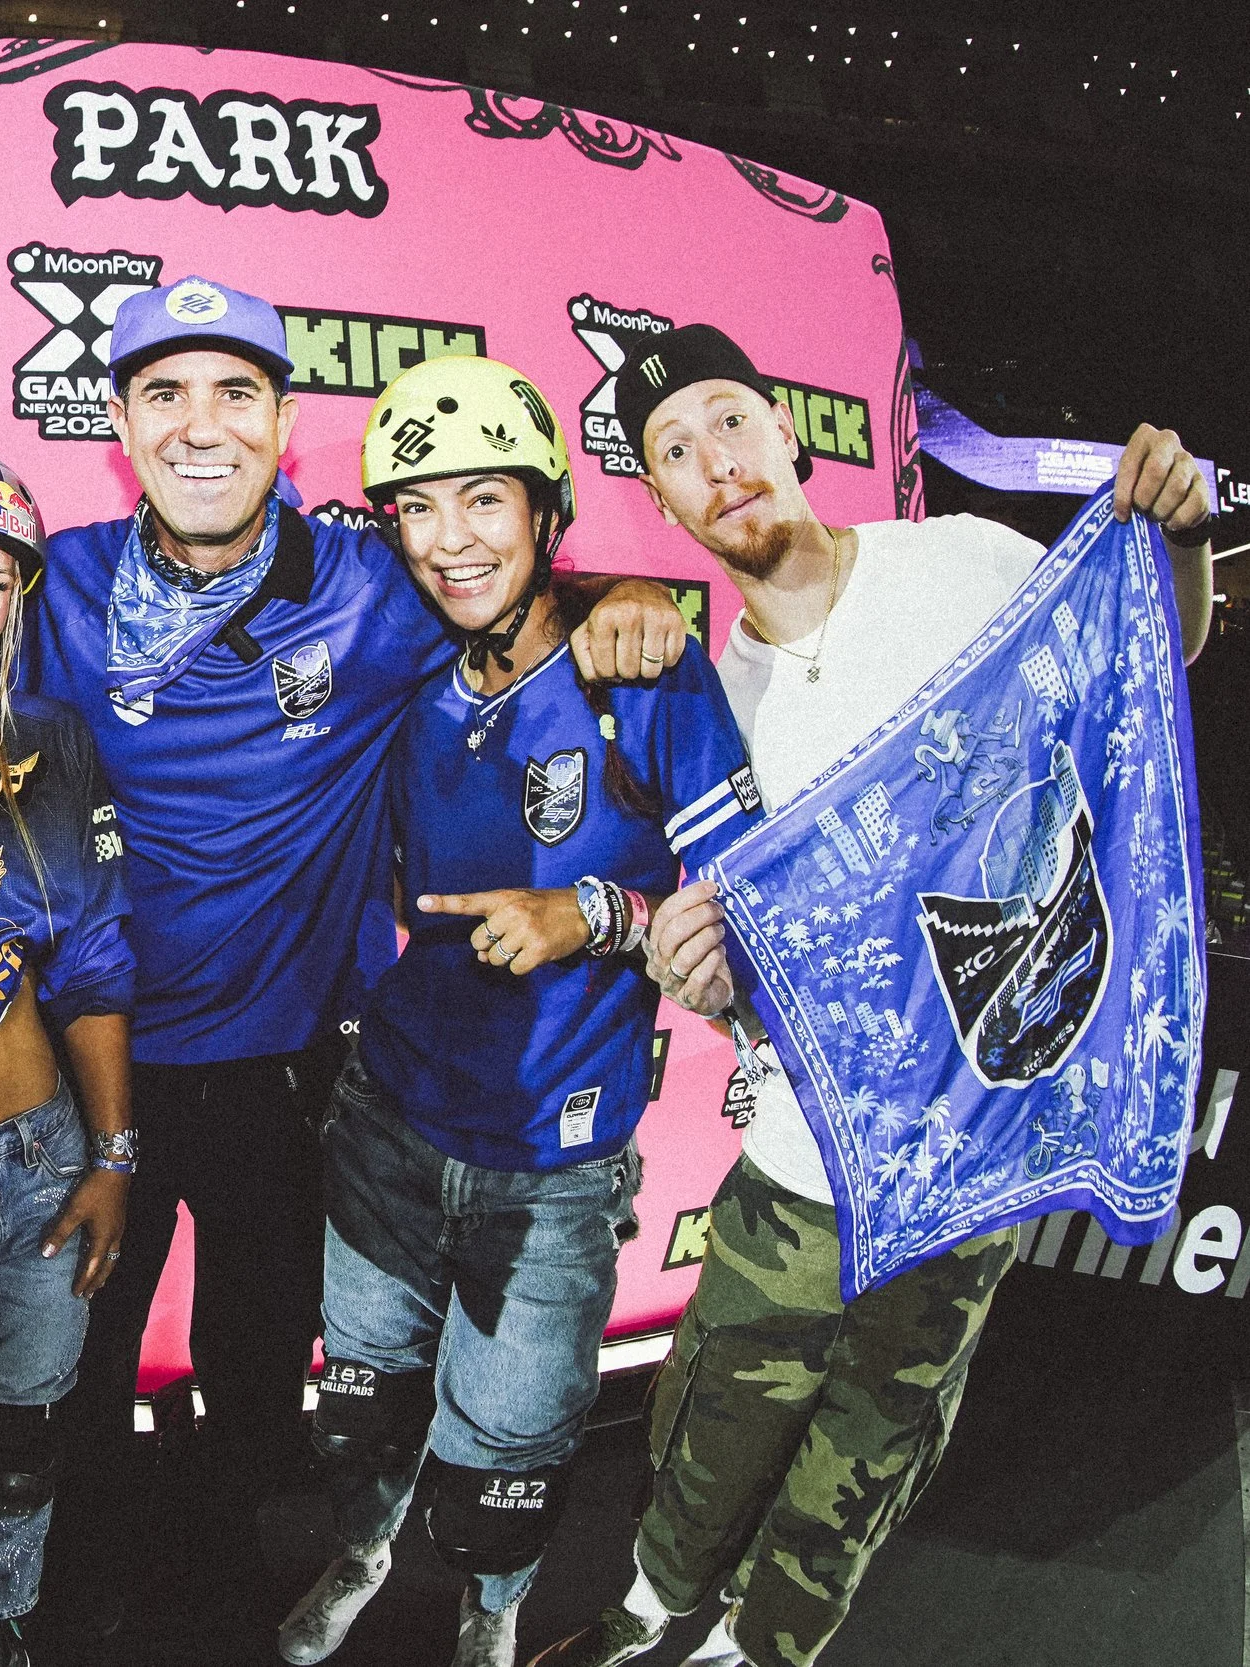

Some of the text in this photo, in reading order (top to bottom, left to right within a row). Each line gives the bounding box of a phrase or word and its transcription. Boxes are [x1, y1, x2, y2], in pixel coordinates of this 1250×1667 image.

[63, 90, 376, 202] PARK
[45, 253, 156, 280] MoonPay
[20, 402, 66, 414] NEW
[46, 416, 113, 435] 202
[770, 385, 869, 460] ICK
[586, 439, 619, 453] NEW
[8, 513, 37, 541] Bull
[724, 1100, 749, 1112] NEW
[326, 1364, 376, 1386] 187
[320, 1380, 375, 1397] KILLER PADS
[487, 1478, 546, 1498] 187
[479, 1494, 544, 1510] KILLER PADS
